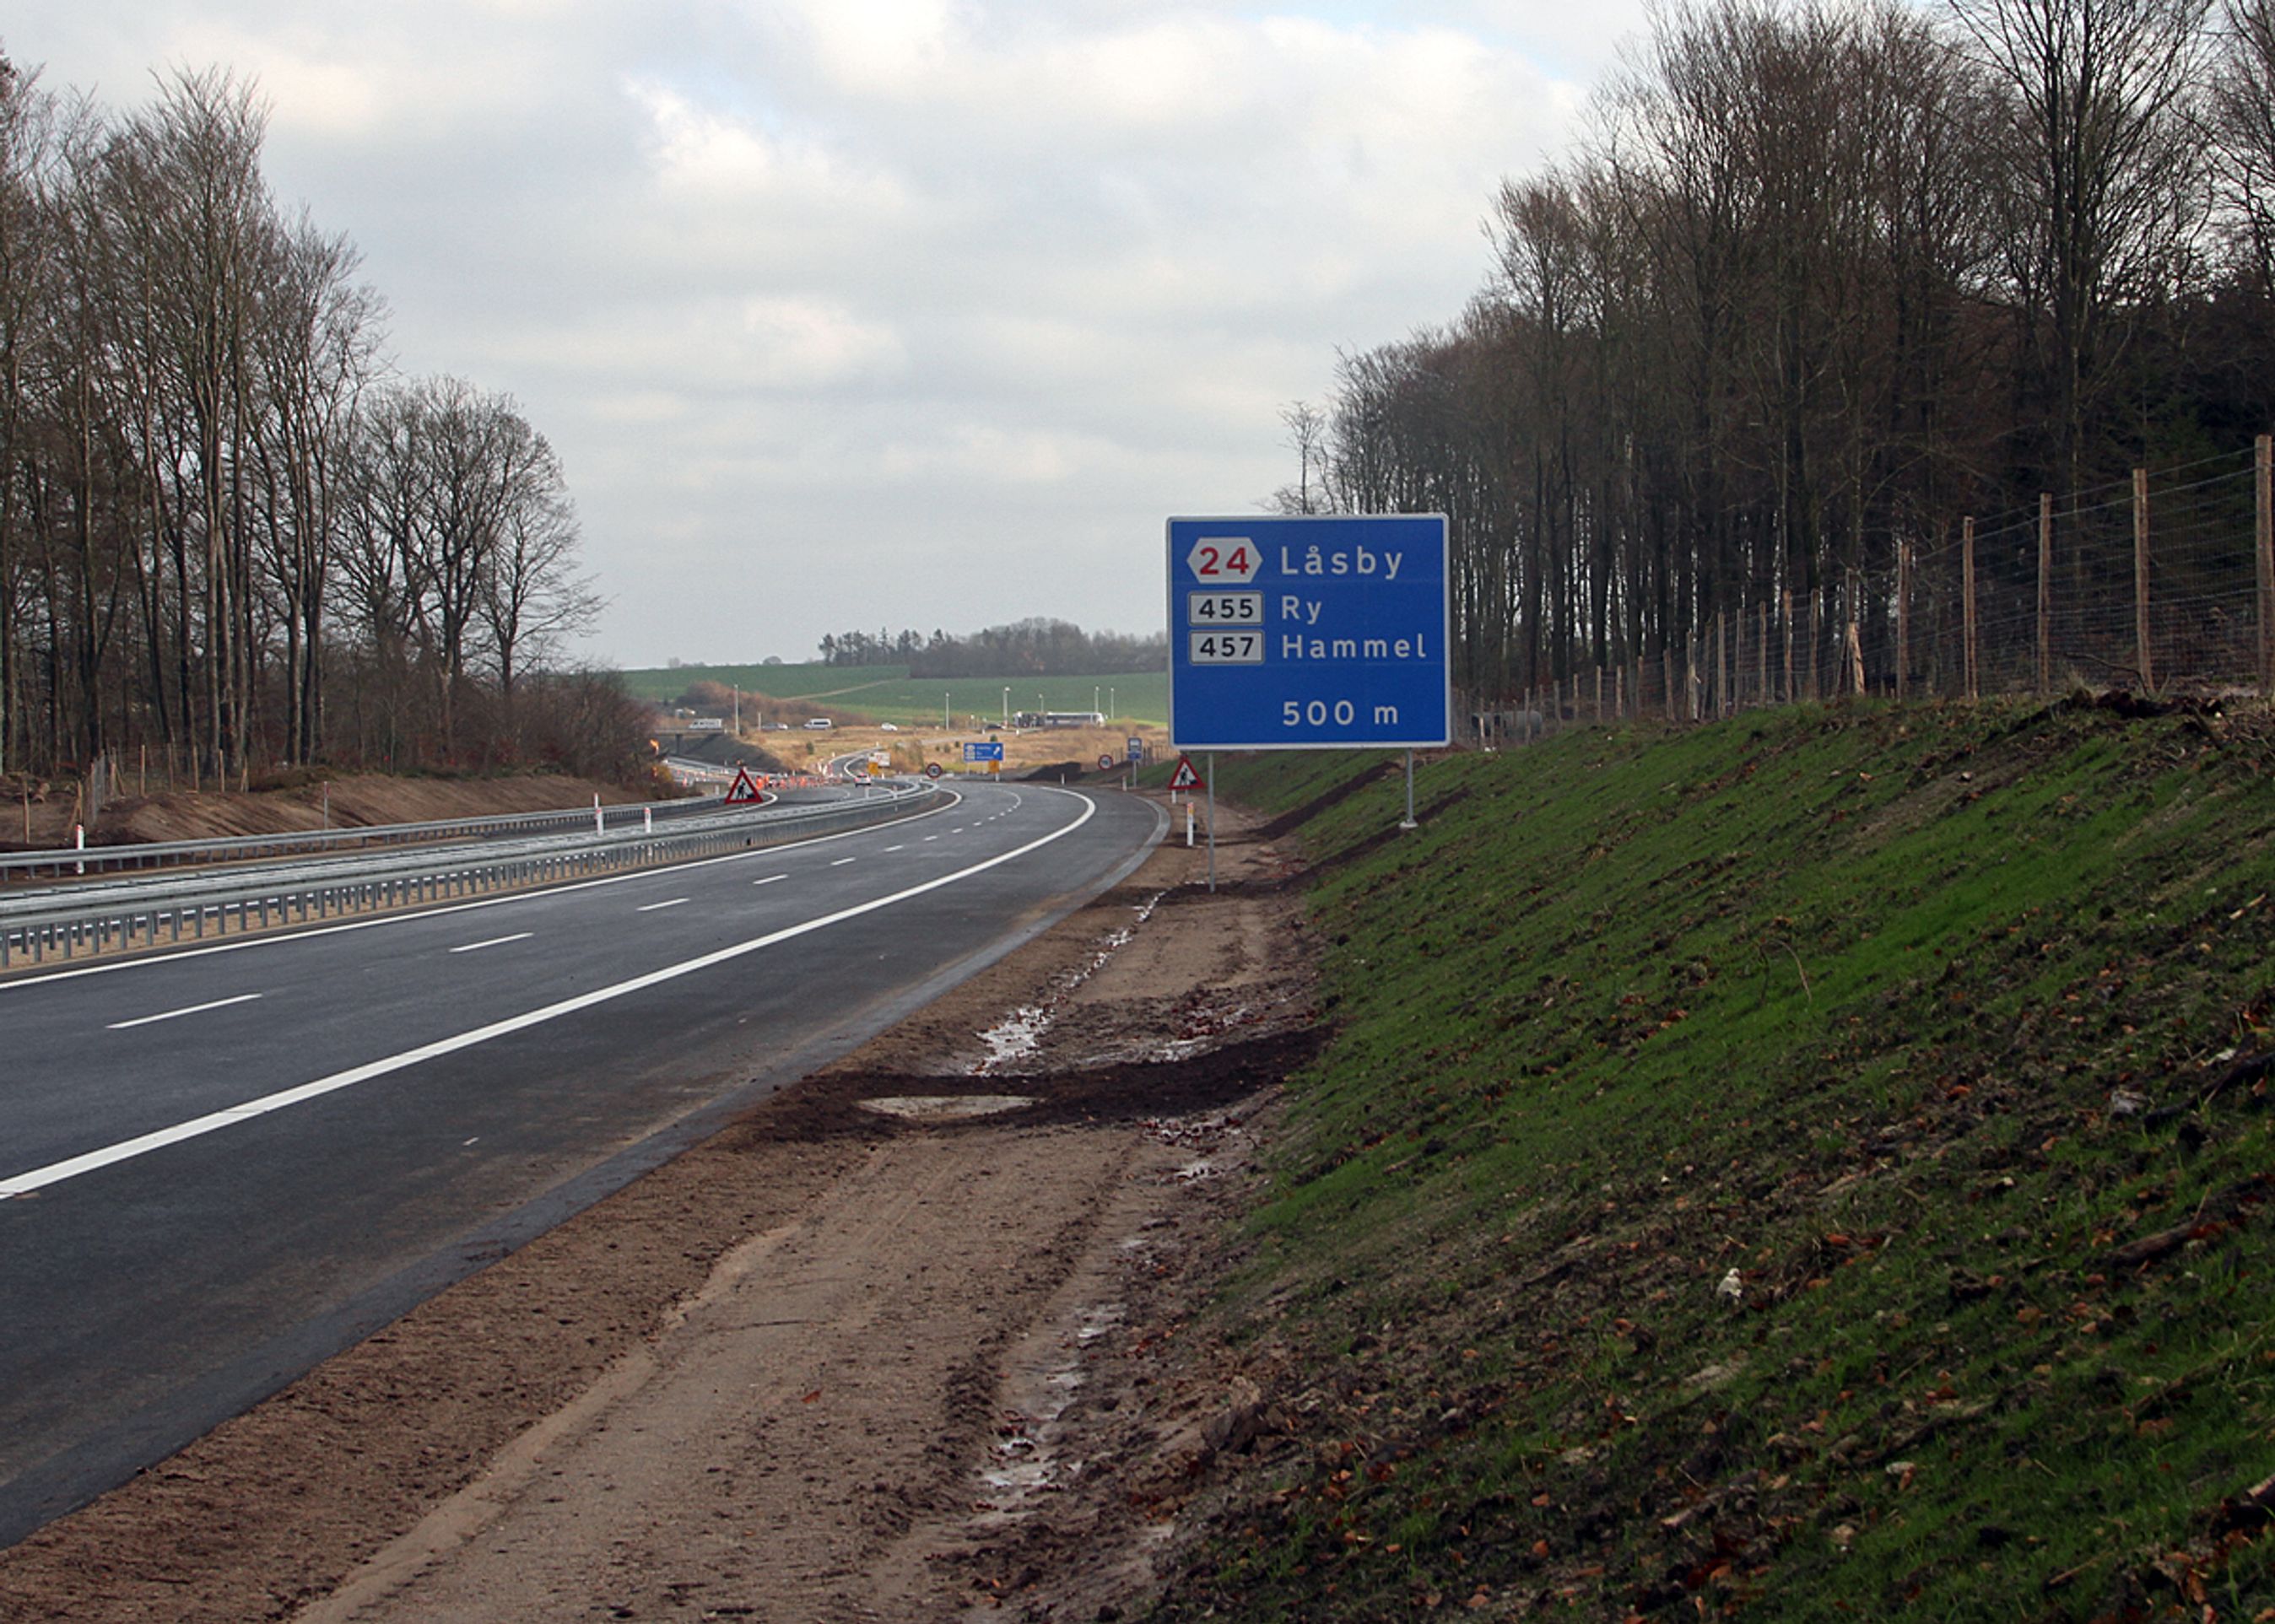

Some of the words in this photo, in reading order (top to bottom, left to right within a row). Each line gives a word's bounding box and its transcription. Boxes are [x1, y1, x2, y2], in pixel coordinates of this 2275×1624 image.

[1199, 546, 1250, 575] 24
[1280, 545, 1403, 580] Låsby
[1198, 598, 1254, 619] 455
[1281, 595, 1322, 625] Ry
[1199, 636, 1255, 657] 457
[1282, 633, 1427, 659] Hammel
[1283, 700, 1354, 726] 500
[1374, 704, 1398, 724] m
